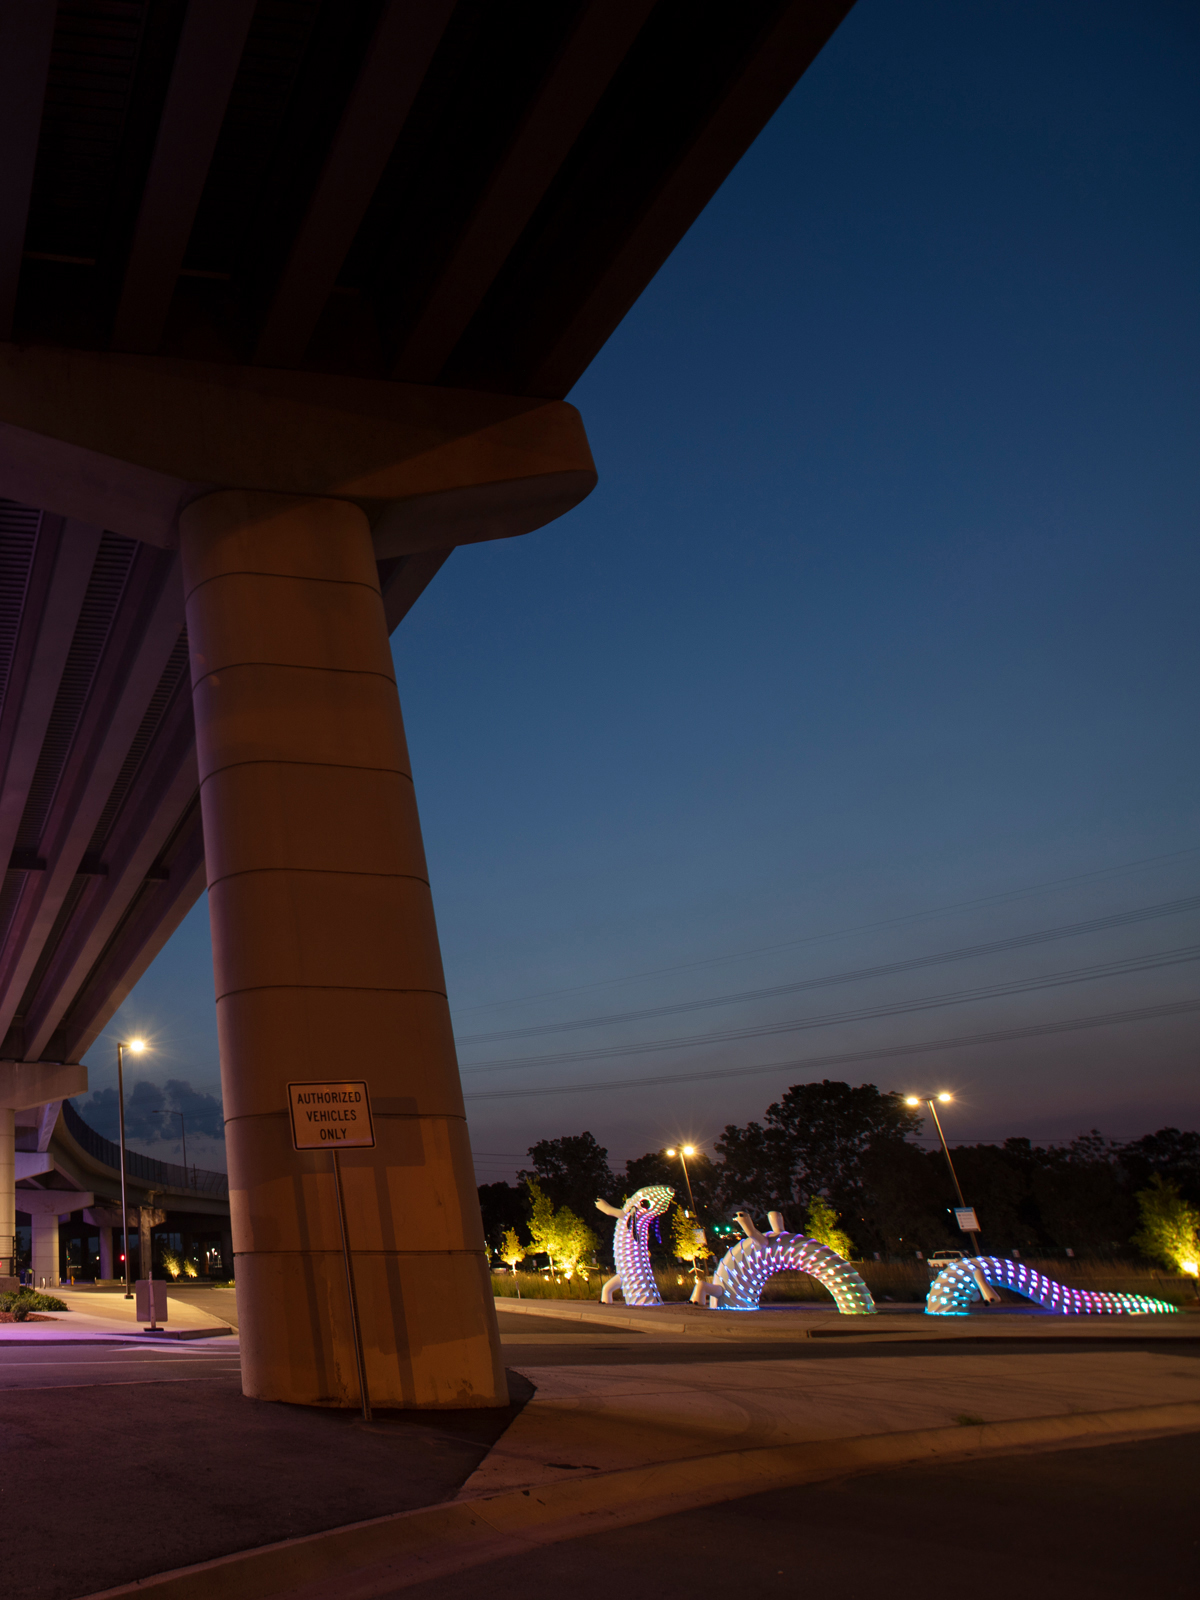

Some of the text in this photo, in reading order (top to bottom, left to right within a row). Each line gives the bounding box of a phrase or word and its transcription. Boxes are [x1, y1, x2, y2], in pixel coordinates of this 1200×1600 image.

[297, 1092, 361, 1104] AUTHORIZED
[306, 1110, 357, 1122] VEHICLES
[320, 1128, 347, 1140] ONLY
